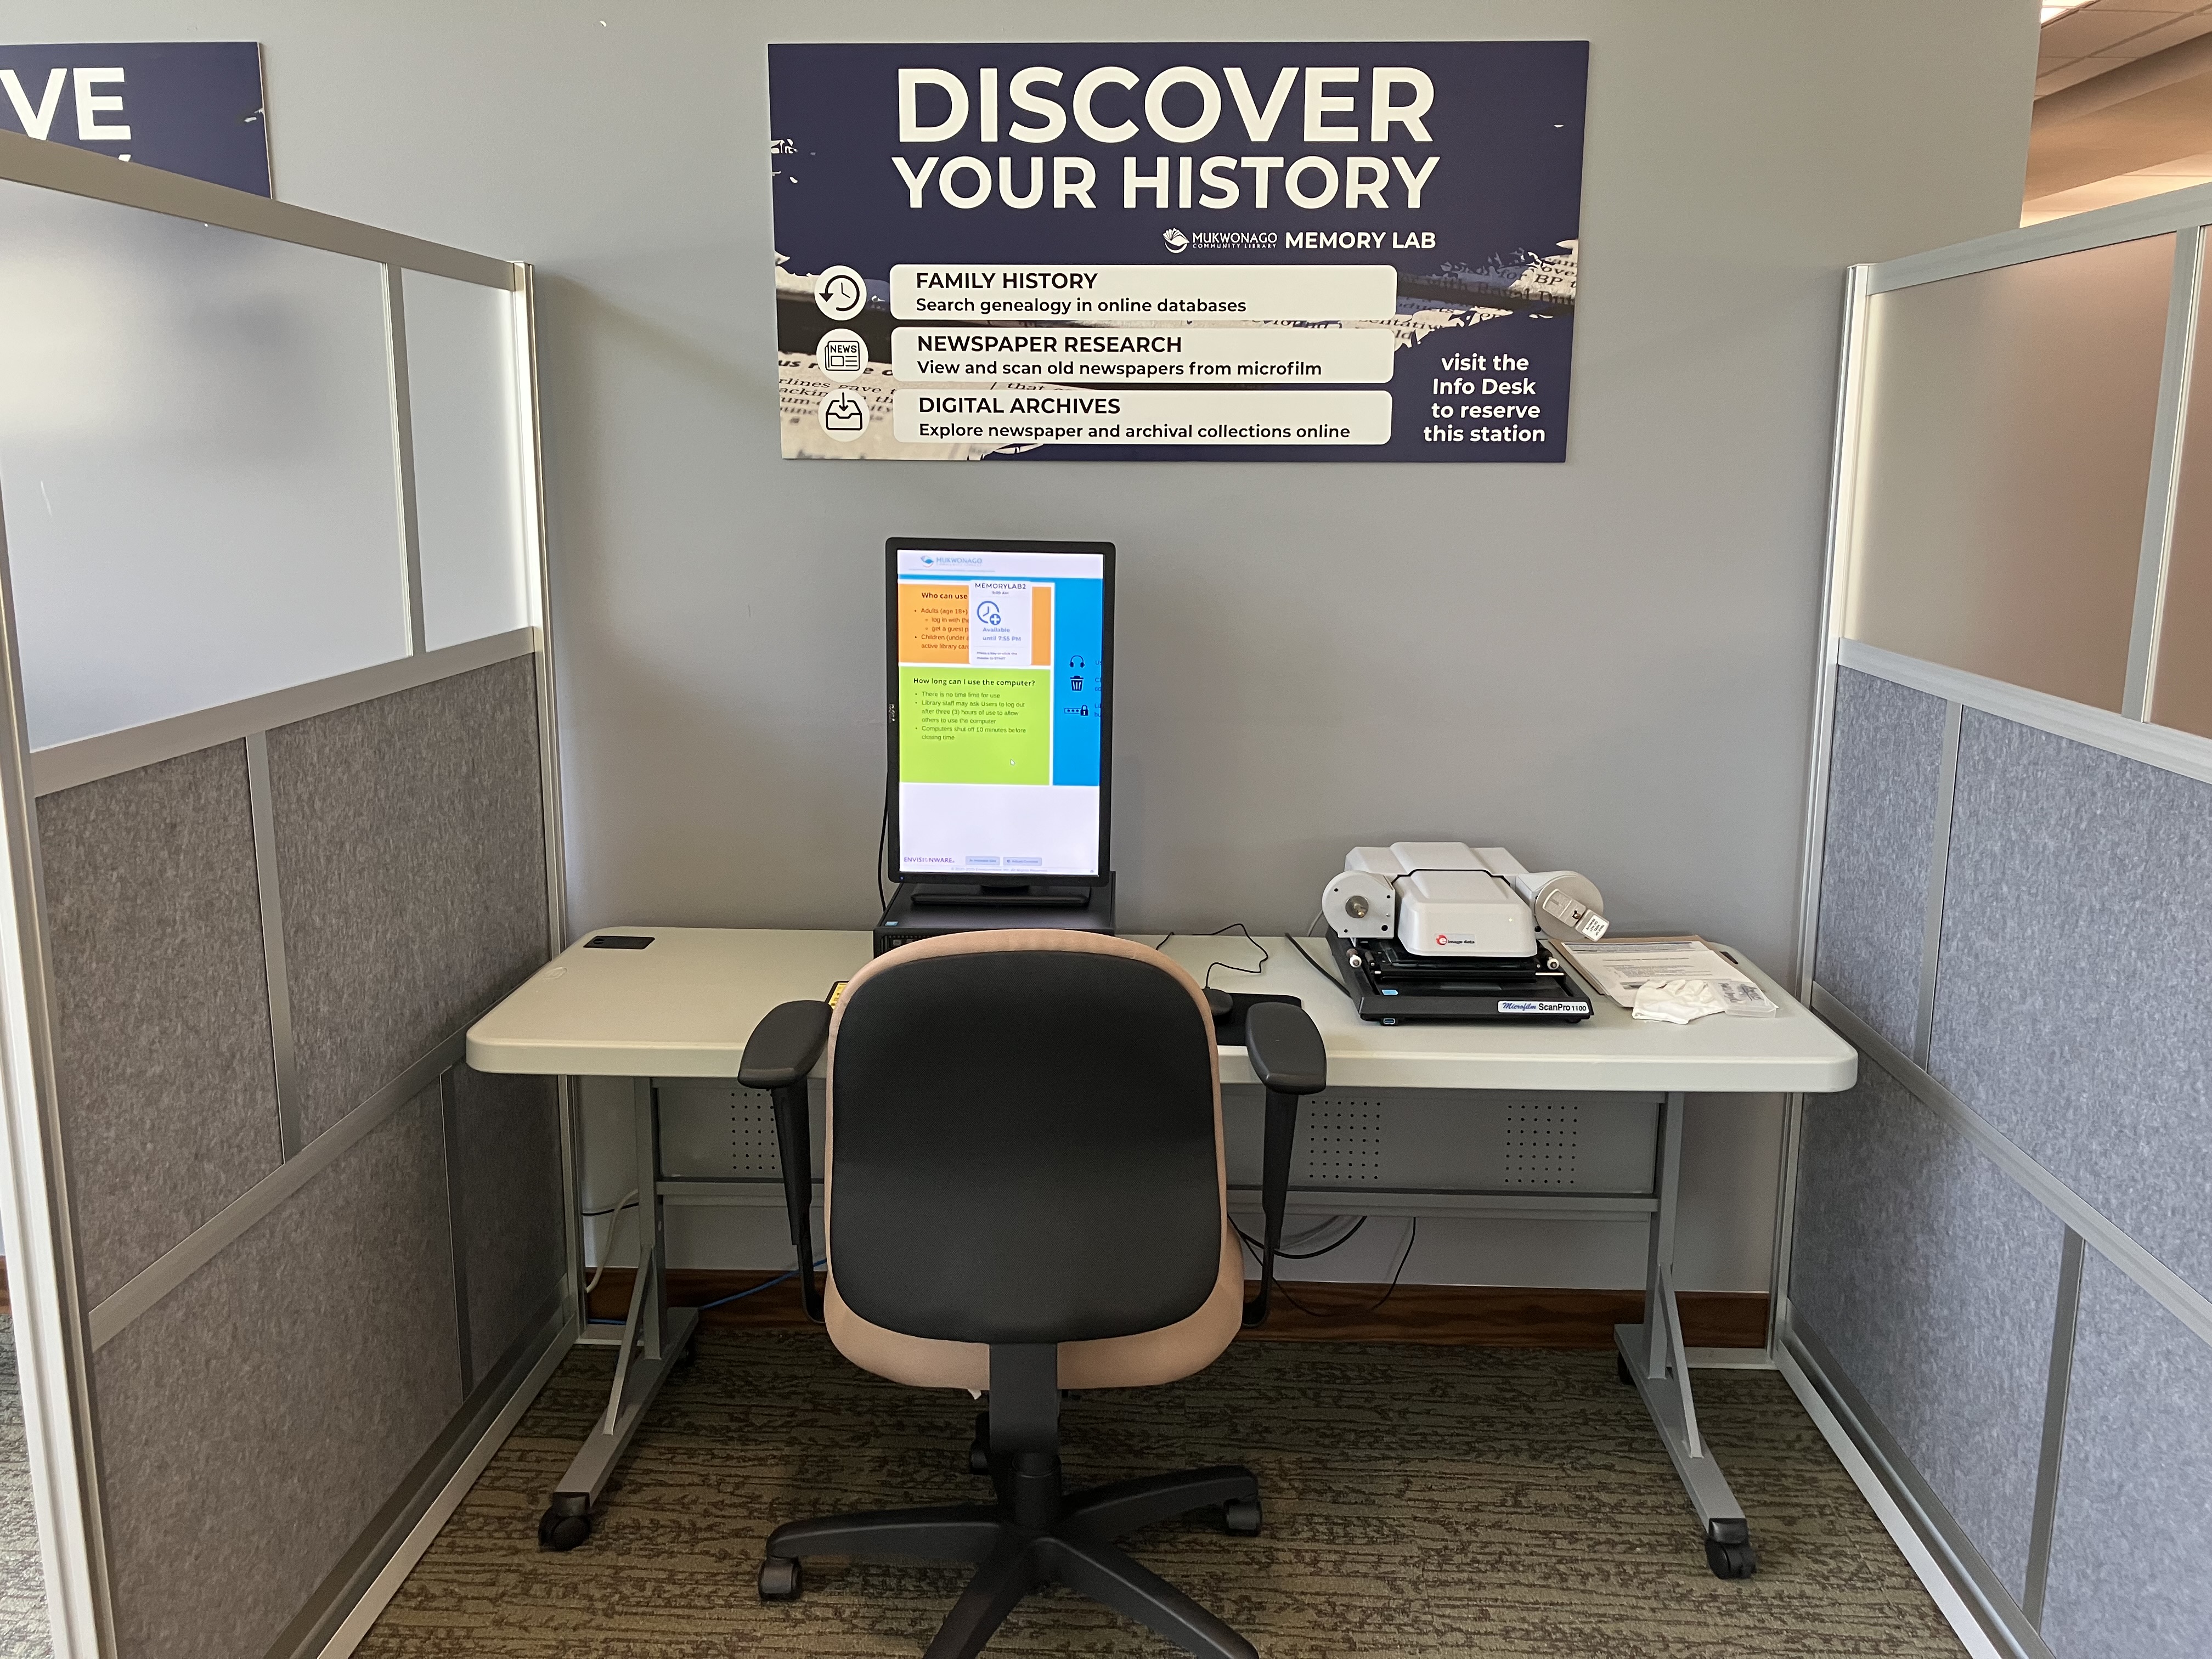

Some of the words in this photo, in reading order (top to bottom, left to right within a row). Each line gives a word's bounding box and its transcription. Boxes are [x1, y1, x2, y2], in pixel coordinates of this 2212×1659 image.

[0, 67, 132, 141] VE
[898, 66, 1434, 144] DISCOVER
[891, 156, 1096, 209] YOUR
[1124, 155, 1441, 209] HISTORY
[1192, 232, 1278, 243] MUKWONAGO
[1285, 232, 1387, 249] MEMORY
[1392, 232, 1436, 249] LAB
[916, 272, 996, 289] FAMILY
[1003, 272, 1098, 289] HISTORY
[916, 298, 974, 312] Search
[980, 298, 1071, 315] genealogy
[1077, 298, 1092, 312] in
[1097, 298, 1152, 312] online
[1157, 298, 1247, 312] databases
[830, 344, 857, 354] NEWS
[917, 336, 1057, 352] NEWSPAPER
[1064, 336, 1182, 353] RESEARCH
[917, 360, 960, 374] View
[964, 360, 997, 374] and
[1002, 364, 1042, 374] scan
[1047, 360, 1074, 375] old
[1080, 364, 1184, 378] newspapers
[1189, 362, 1232, 375] from
[1237, 362, 1322, 375] microfilm
[1442, 353, 1486, 371] visit
[1493, 354, 1529, 371] the
[1432, 378, 1475, 395] Info
[1482, 377, 1536, 395] Desk
[919, 397, 1005, 414] DIGITAL
[1010, 398, 1120, 414] ARCHIVES
[1432, 403, 1454, 419] to
[1460, 405, 1541, 419] reserve
[919, 422, 983, 438] Explore
[989, 426, 1082, 440] newspaper
[1088, 424, 1120, 438] and
[1125, 424, 1192, 438] archival
[1197, 424, 1291, 438] collections
[1296, 424, 1351, 438] online
[1424, 424, 1464, 442] this
[1470, 425, 1546, 442] station
[1502, 1002, 1537, 1012] Microfilm
[1538, 1003, 1571, 1011] ScanPro
